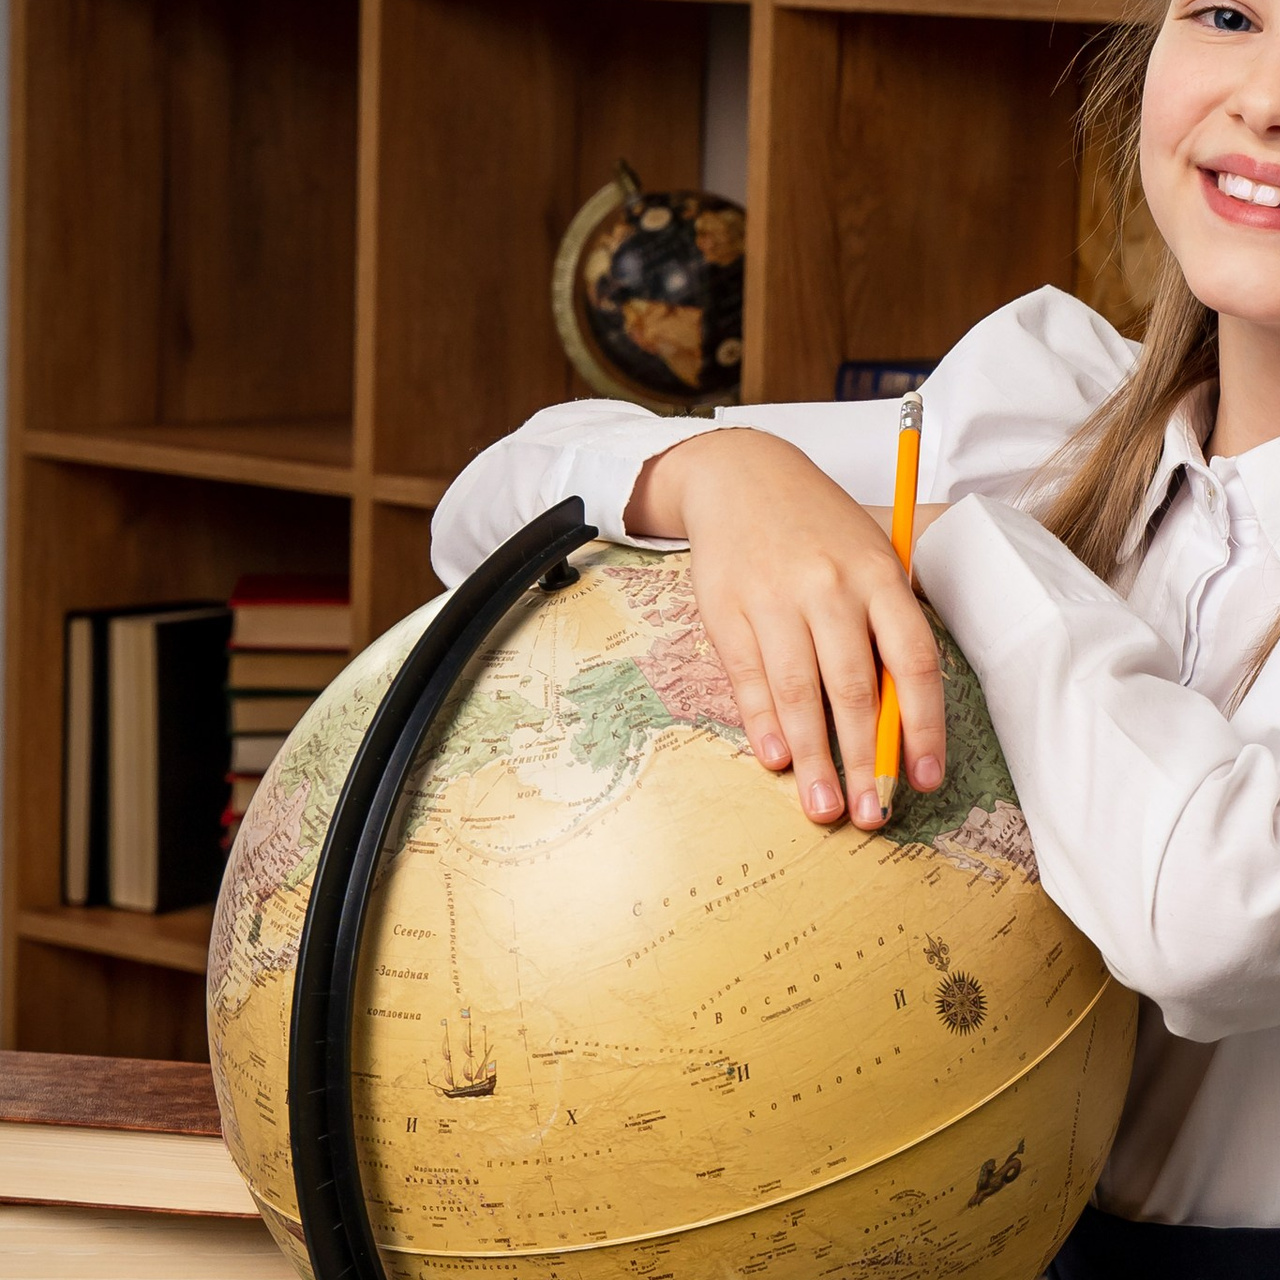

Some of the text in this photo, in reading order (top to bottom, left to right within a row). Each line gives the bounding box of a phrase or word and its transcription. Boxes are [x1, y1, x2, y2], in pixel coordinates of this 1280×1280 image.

[606, 628, 628, 642] МОРЕ
[500, 752, 558, 766] БЕРИНГОВО
[516, 789, 543, 799] МОРЕ
[625, 868, 786, 968] разлом Мендосино
[393, 924, 437, 940] Северо-
[692, 923, 818, 1020] разлом Меррей
[366, 1007, 422, 1020] котловина
[760, 997, 812, 1023] Северный тропик
[405, 1177, 479, 1185] МАРШАЛЛОВЫ
